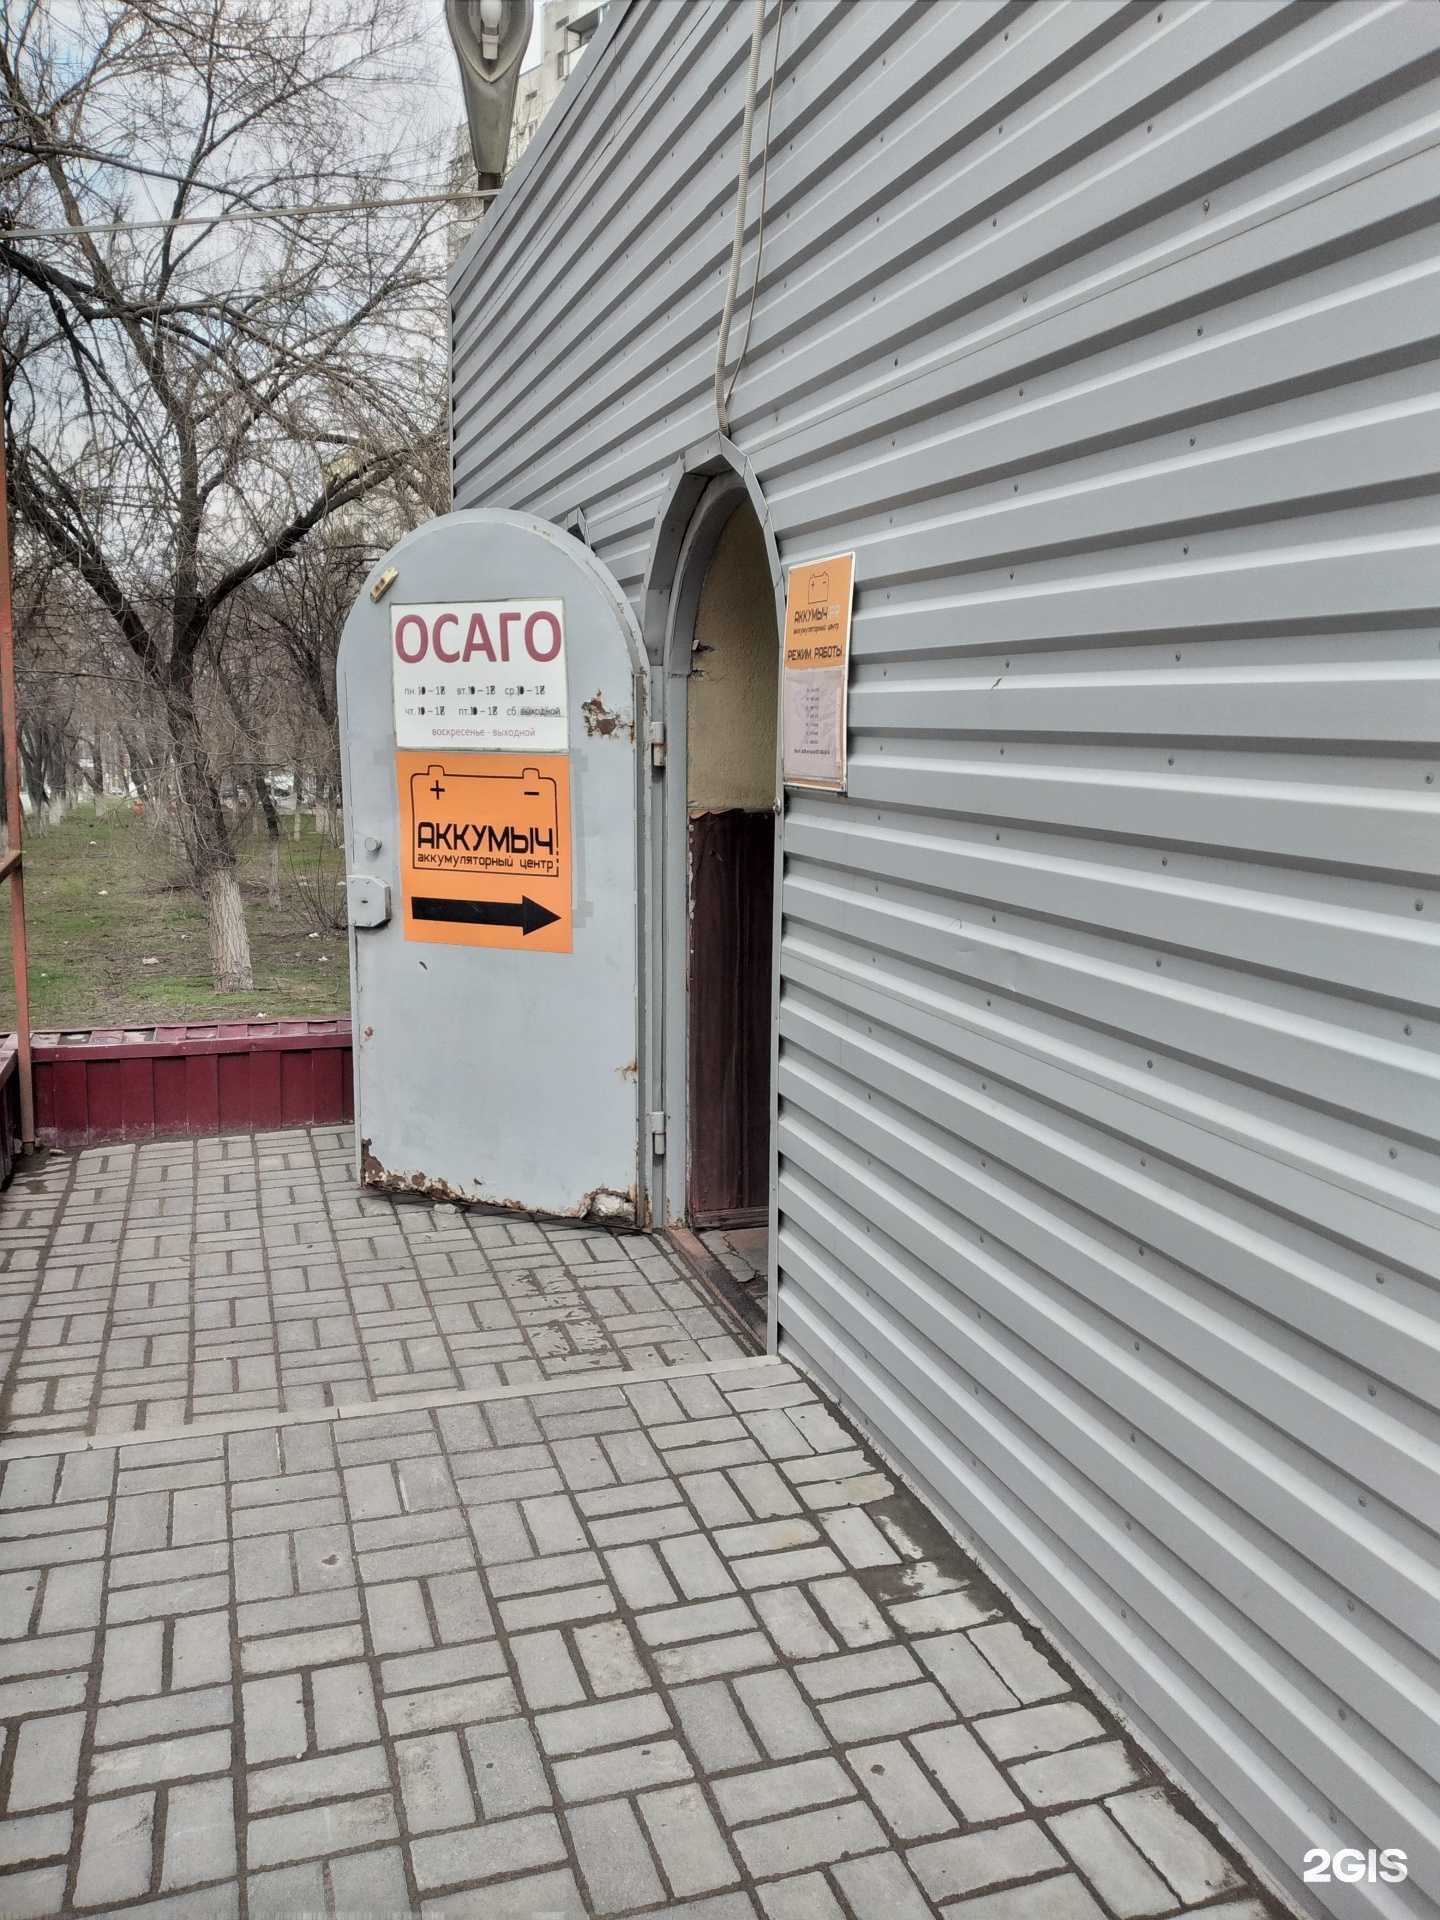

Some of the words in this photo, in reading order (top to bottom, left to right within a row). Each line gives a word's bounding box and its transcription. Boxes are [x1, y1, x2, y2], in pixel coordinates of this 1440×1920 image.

[395, 610, 562, 664] ОСАГО
[787, 648, 812, 660] РЕЖИМ
[813, 644, 843, 659] РАБОТЫ
[431, 728, 485, 738] воскресенье
[492, 727, 536, 738] выходной
[417, 821, 554, 855] АККУМЫЧ
[417, 853, 513, 868] аккумуляторный
[519, 857, 554, 872] центр
